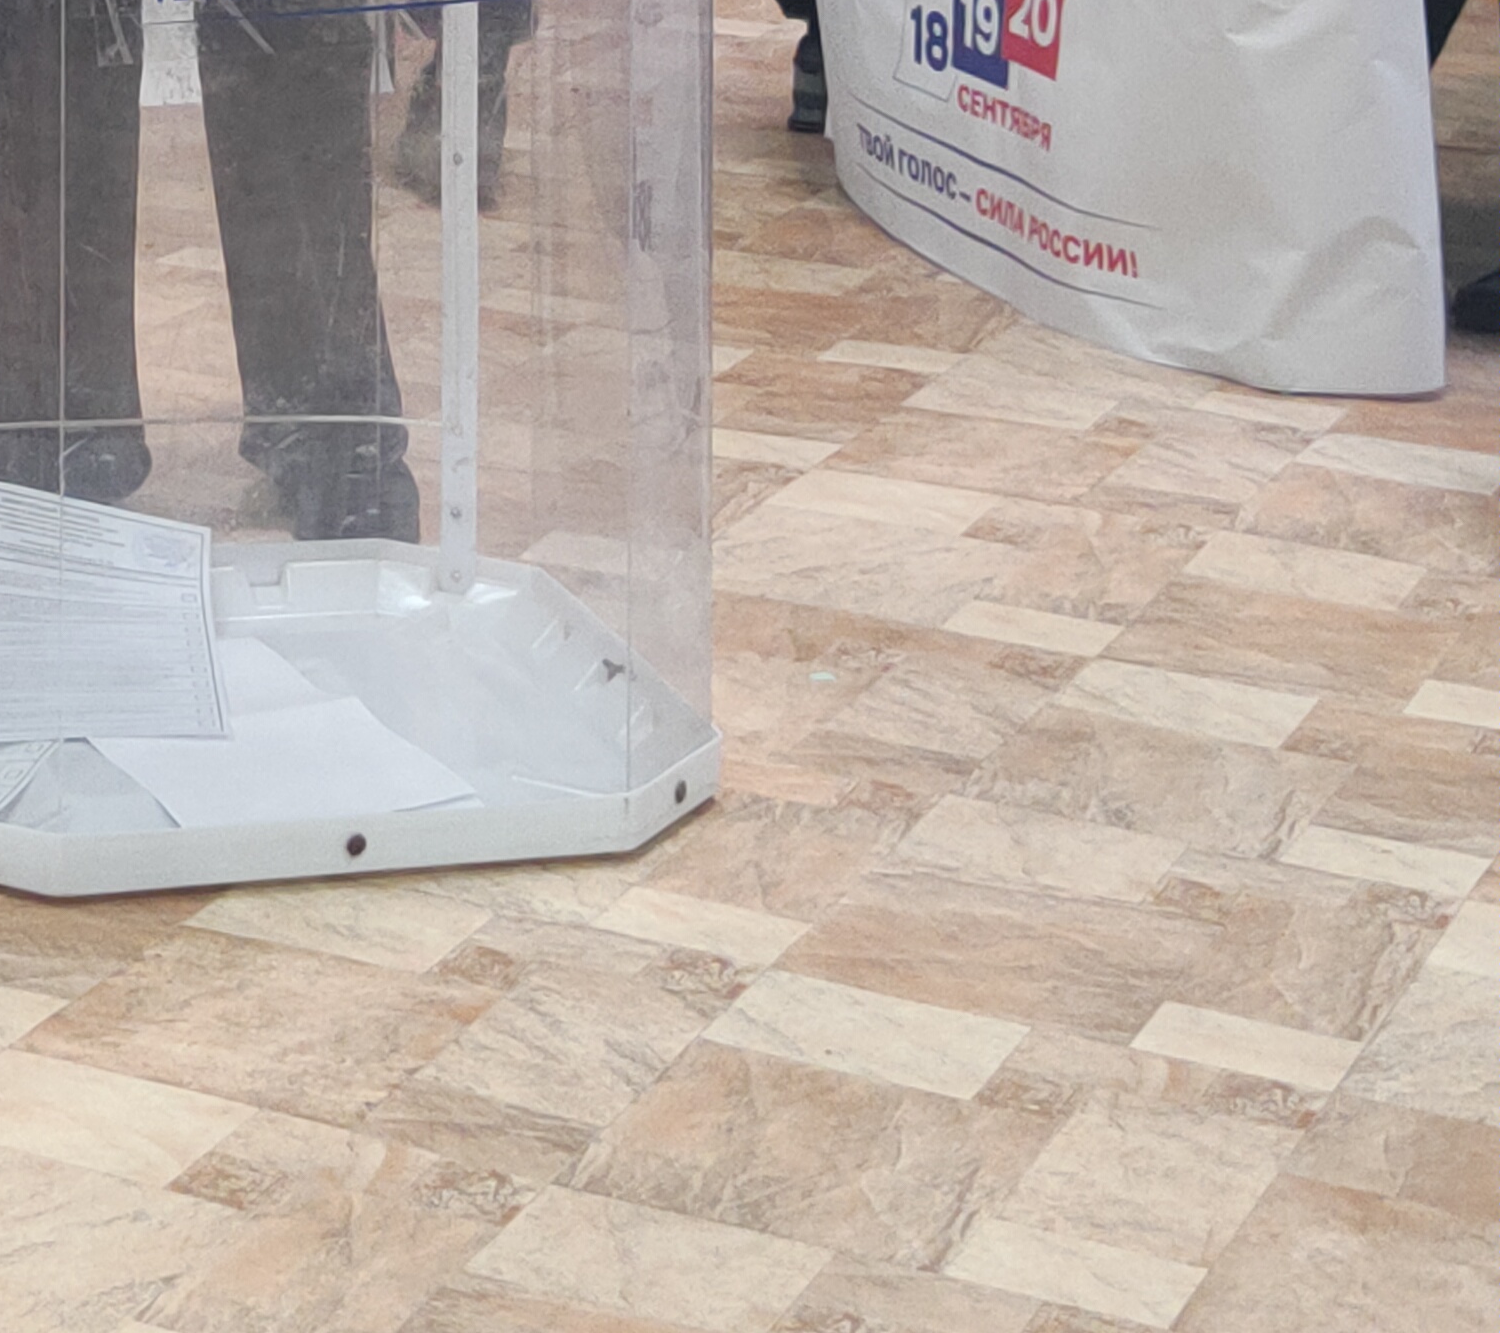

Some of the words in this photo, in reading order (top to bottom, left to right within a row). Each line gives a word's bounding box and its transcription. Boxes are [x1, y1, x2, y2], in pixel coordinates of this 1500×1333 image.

[910, 5, 949, 72] 18
[957, 84, 1052, 152] СЕНТЯБРЯ
[857, 122, 895, 167] ТВОЙ
[898, 148, 957, 201] ГОЛОС
[976, 188, 1025, 236] СИЛА
[1027, 217, 1140, 279] РОССИИ!
